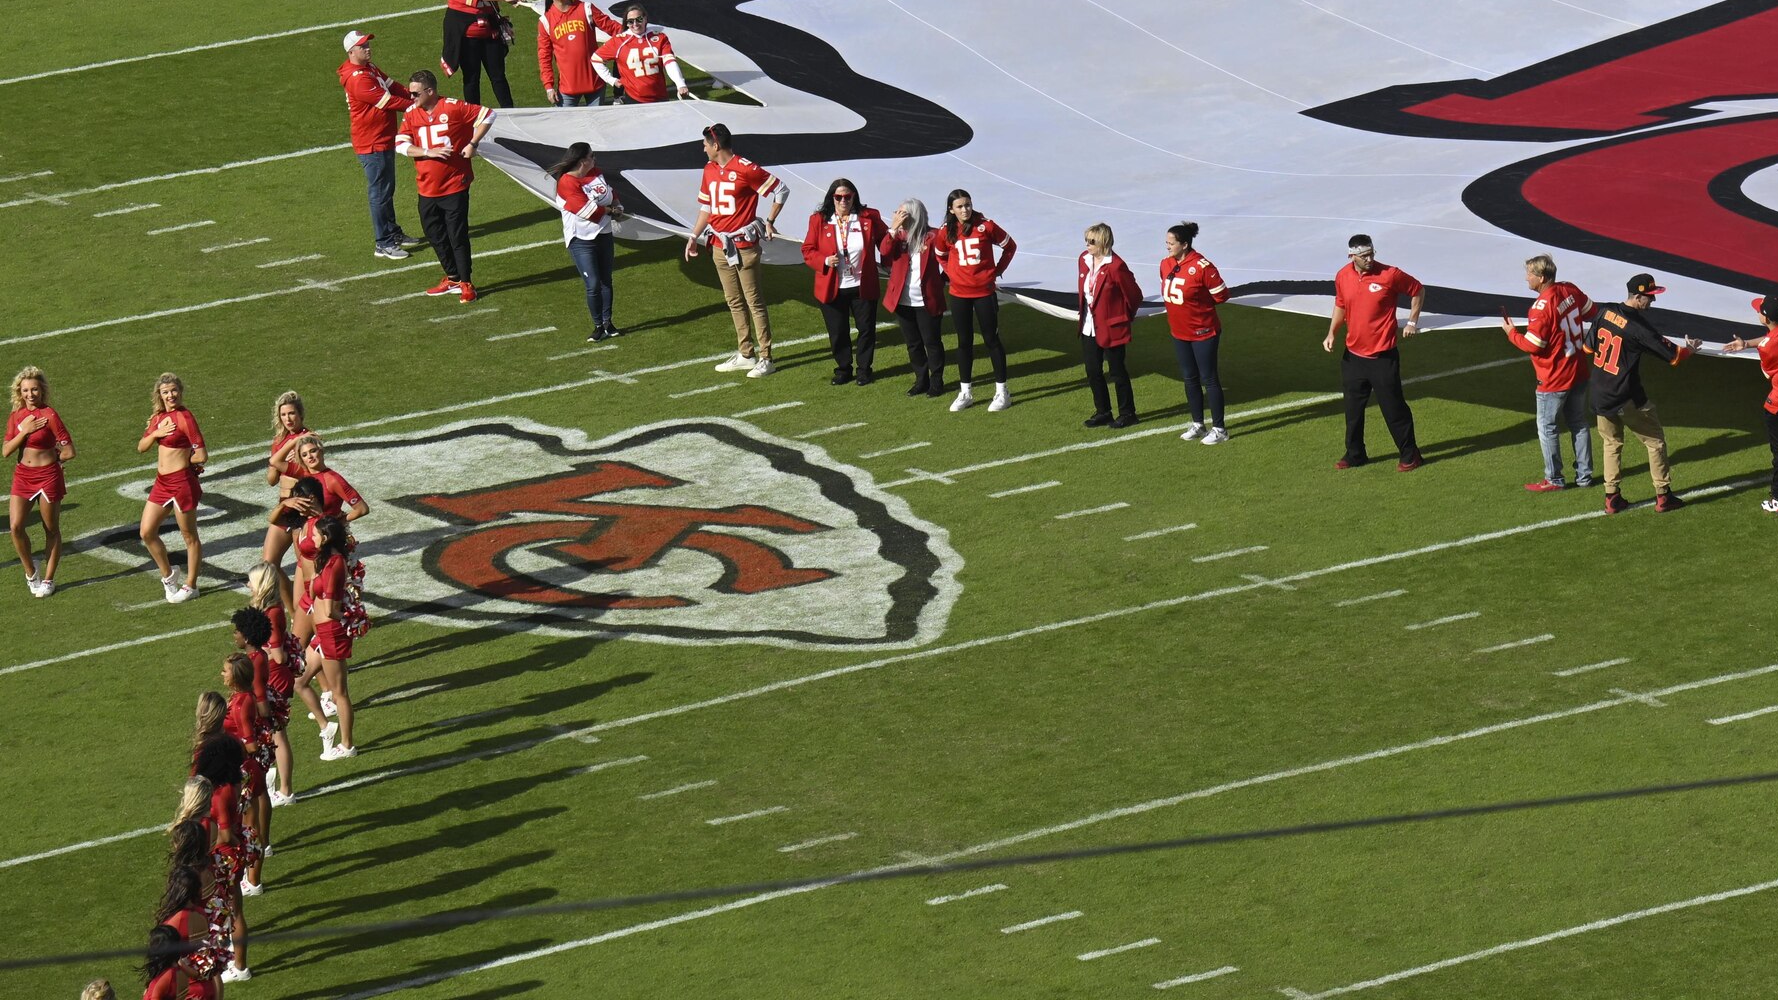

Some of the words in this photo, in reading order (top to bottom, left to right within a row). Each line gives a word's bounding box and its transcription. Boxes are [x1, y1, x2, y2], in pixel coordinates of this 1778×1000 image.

[554, 19, 586, 41] CHIEFS
[625, 47, 660, 78] 42
[417, 123, 450, 149] 15
[710, 182, 736, 215] 15
[954, 238, 982, 267] 15
[1163, 277, 1184, 306] 15
[1559, 306, 1583, 358] 15
[1593, 328, 1624, 376] 31
